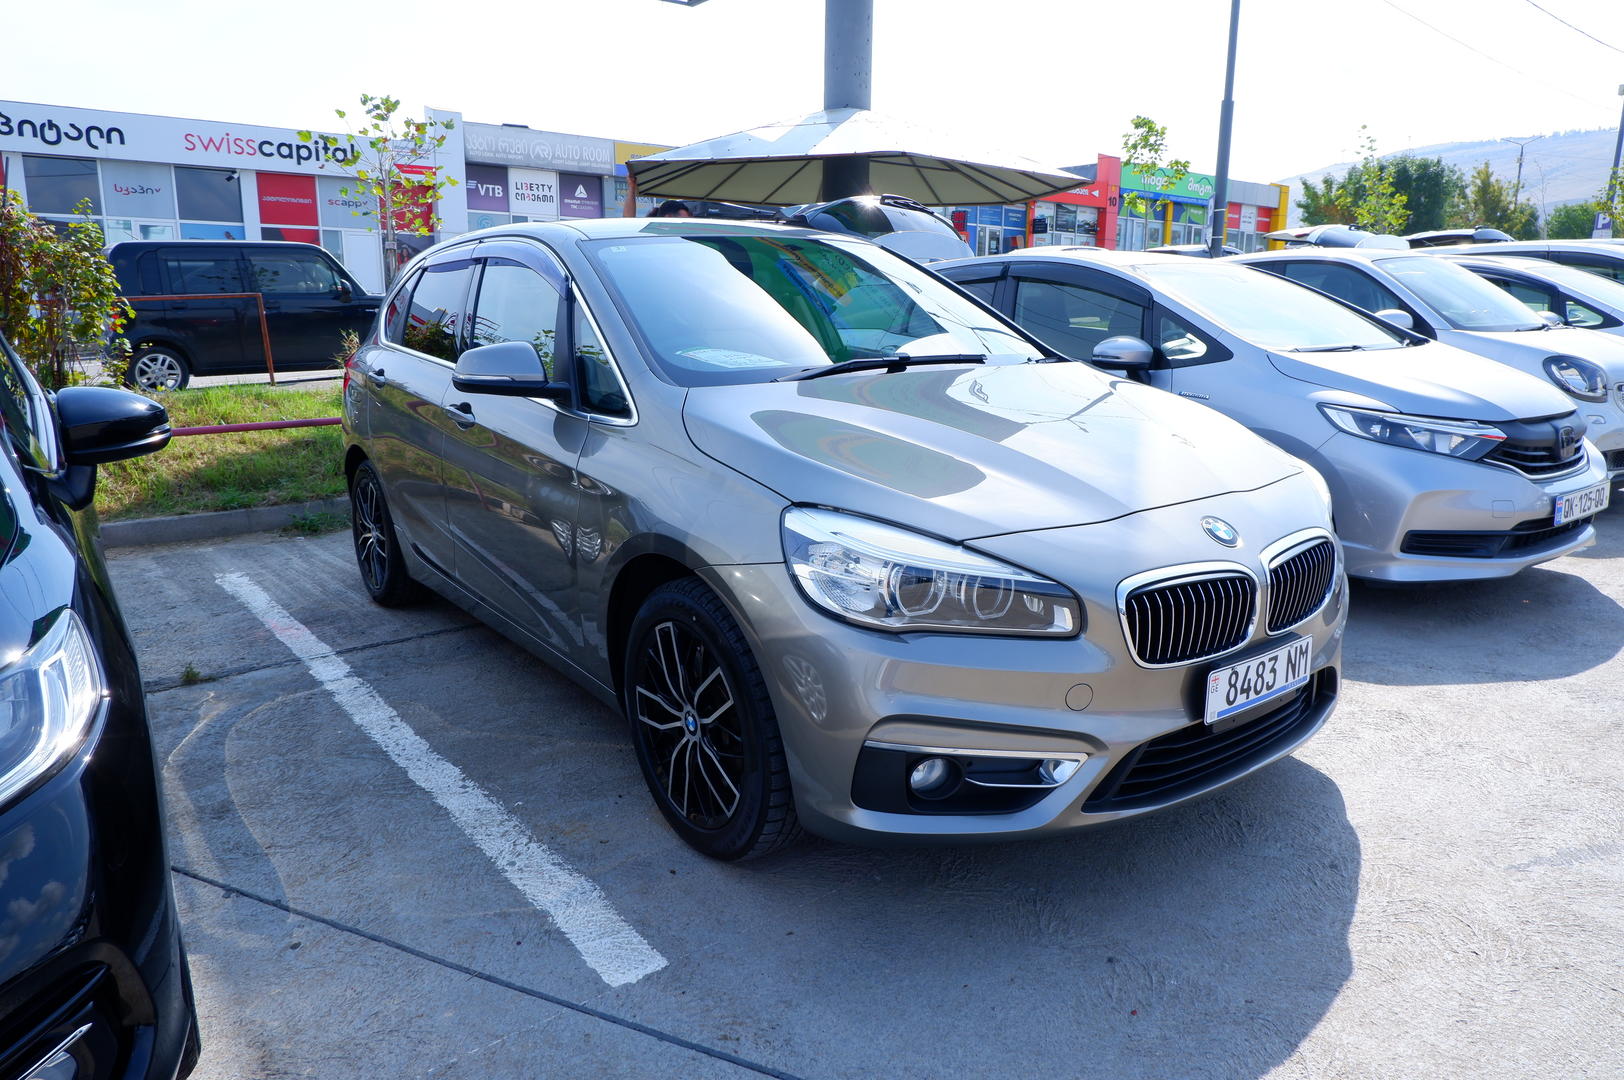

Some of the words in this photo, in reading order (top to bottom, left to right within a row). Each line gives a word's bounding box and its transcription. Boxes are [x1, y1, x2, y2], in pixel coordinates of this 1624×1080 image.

[555, 143, 580, 160] AUTO
[583, 146, 610, 163] ROOM
[478, 183, 503, 197] VTB
[515, 182, 553, 192] LIBERTY
[1108, 197, 1117, 206] 10
[1597, 213, 1610, 228] P
[1225, 654, 1279, 706] 8483
[1285, 641, 1309, 683] NM
